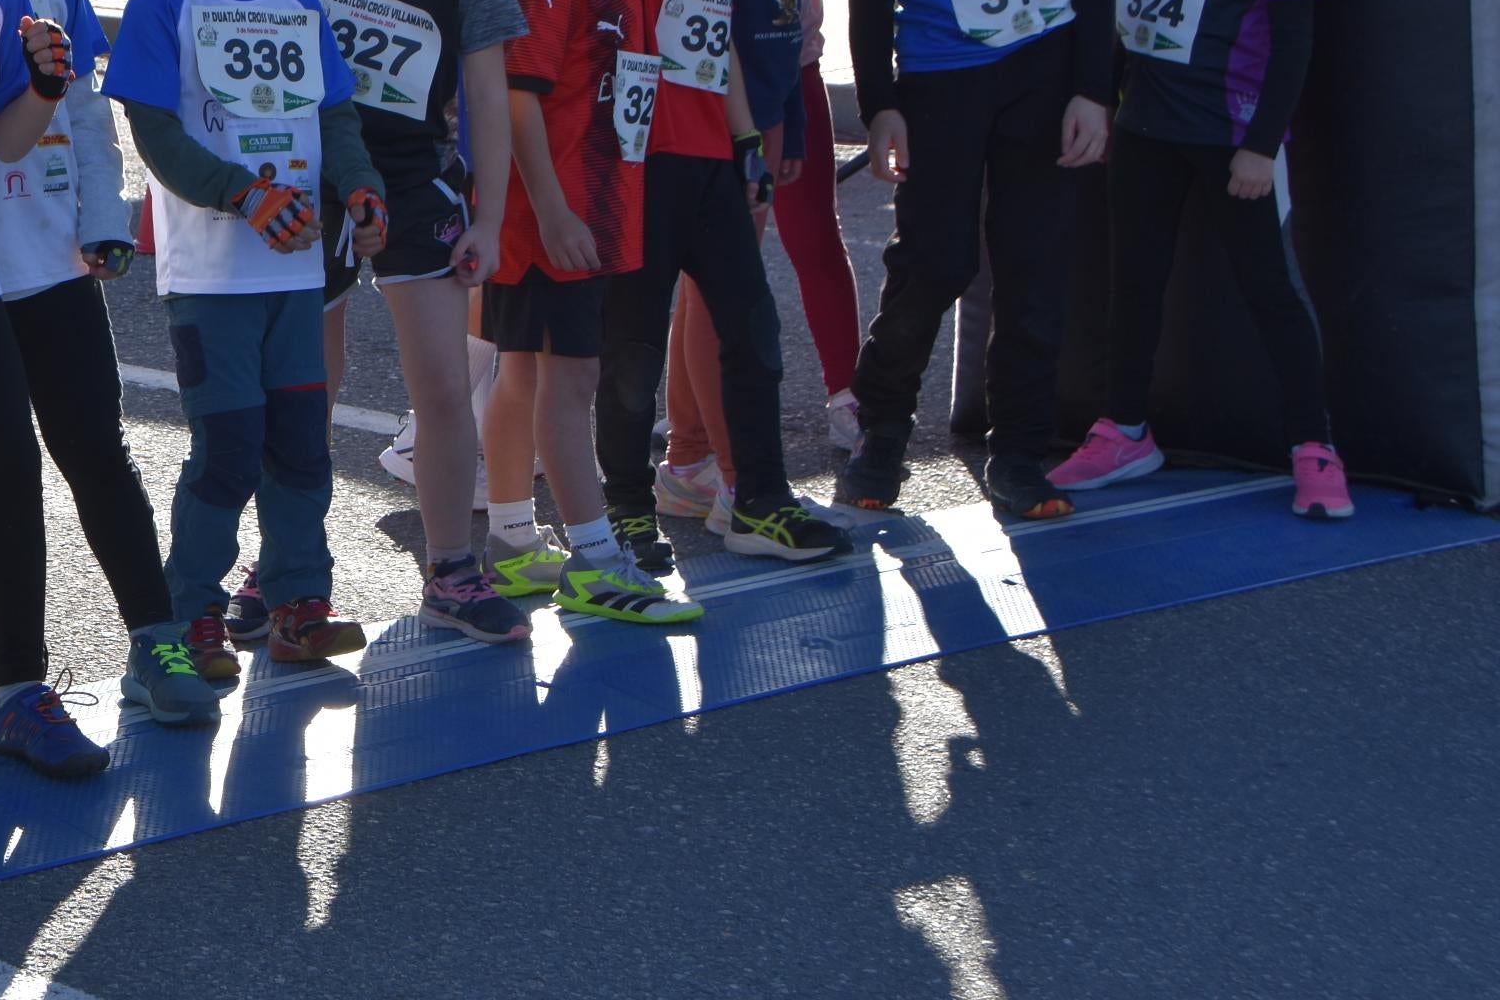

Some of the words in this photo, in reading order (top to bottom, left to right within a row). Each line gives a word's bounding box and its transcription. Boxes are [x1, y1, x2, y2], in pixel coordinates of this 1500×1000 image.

[212, 9, 247, 22] DUATLÓN
[248, 11, 267, 24] CROSS
[268, 13, 308, 26] VILLAMAYOR
[367, 1, 390, 18] CROSS
[391, 7, 434, 32] VILLAMAYOR
[224, 38, 305, 82] 336
[332, 19, 422, 77] 327
